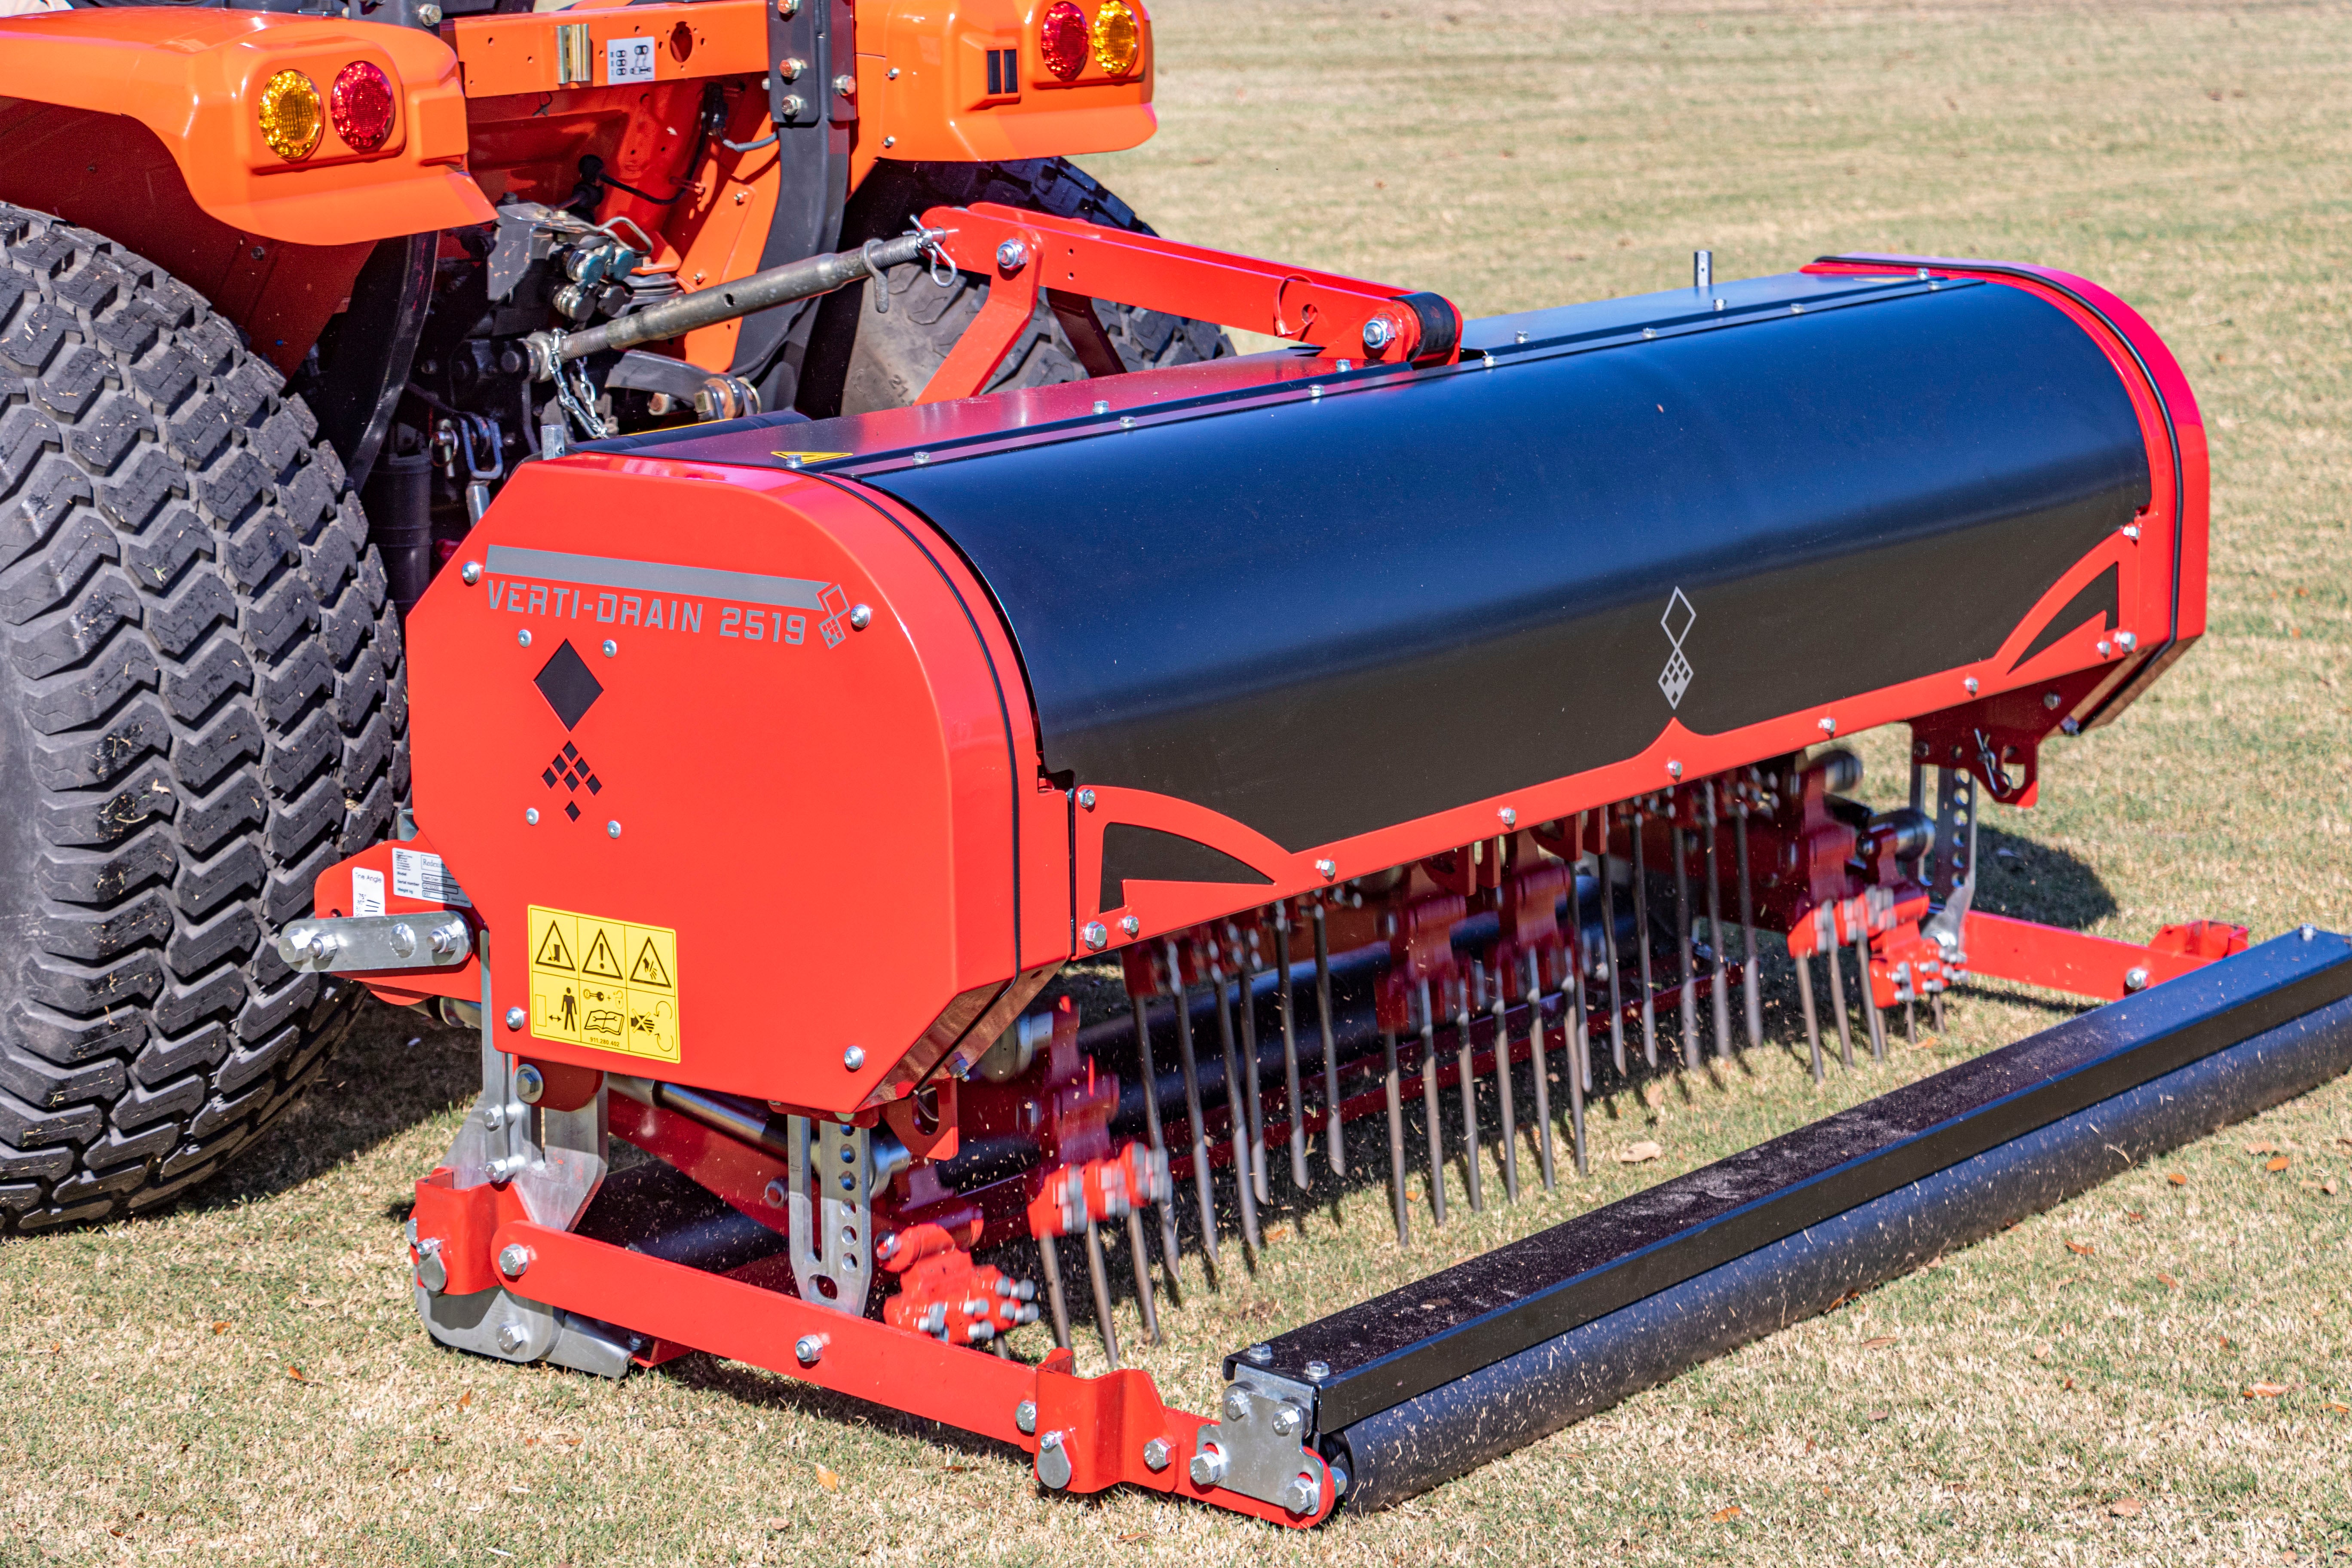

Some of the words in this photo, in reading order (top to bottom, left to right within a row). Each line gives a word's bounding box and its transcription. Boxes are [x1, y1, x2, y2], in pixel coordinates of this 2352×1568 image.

[487, 580, 703, 633] VERTI-DRAIN
[720, 607, 806, 645] 2519
[366, 875, 382, 883] Angle
[590, 1037, 620, 1047] 911.280.402
